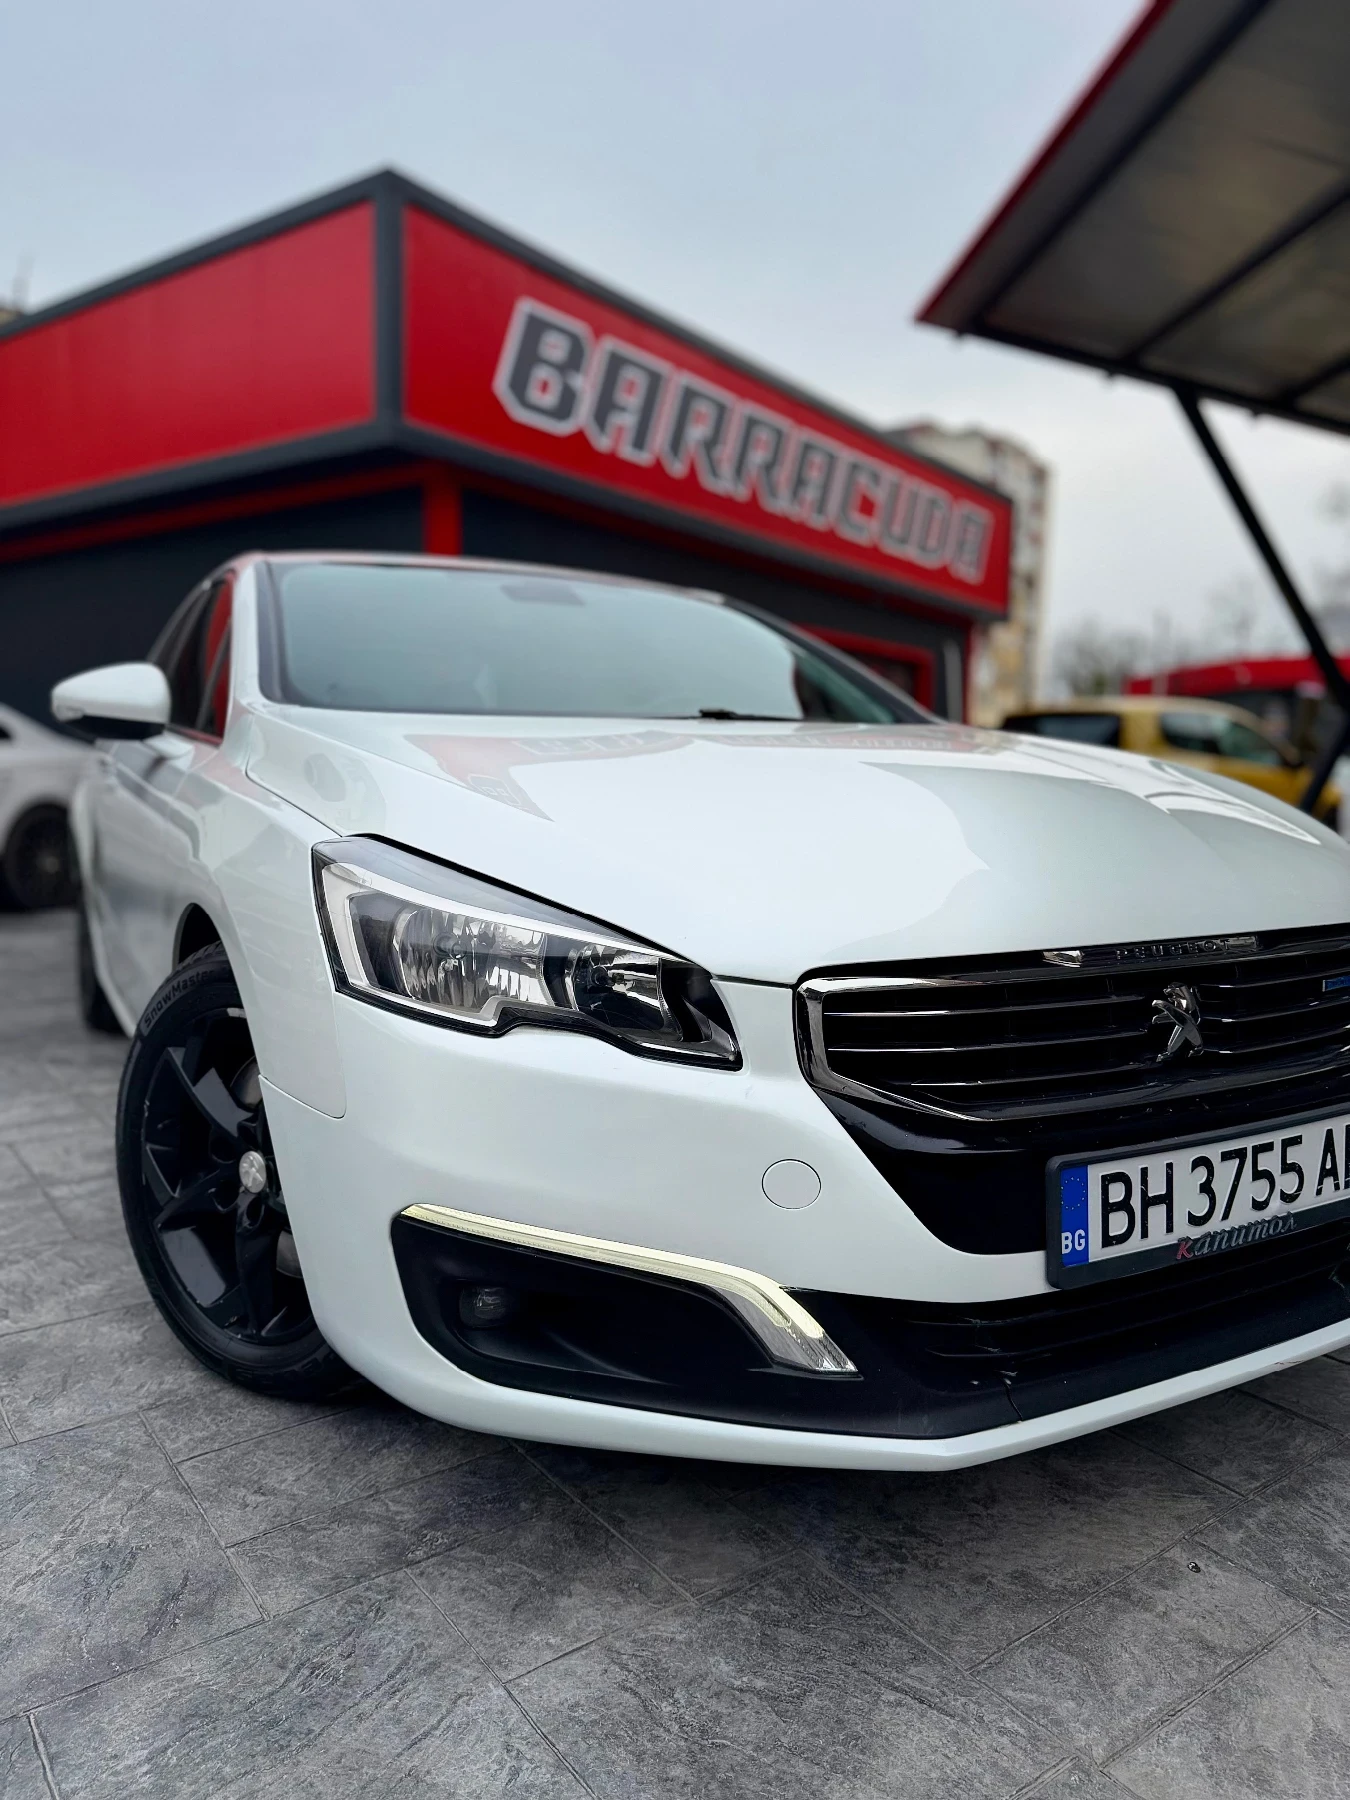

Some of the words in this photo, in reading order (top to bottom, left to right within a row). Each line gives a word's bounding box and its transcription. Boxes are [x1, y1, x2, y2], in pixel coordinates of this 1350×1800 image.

[493, 297, 994, 584] BARRACUDA
[1116, 940, 1230, 960] PEUGEOT
[1101, 1162, 1174, 1249] BH
[1187, 1135, 1304, 1227] 3755
[1061, 1230, 1086, 1255] BG
